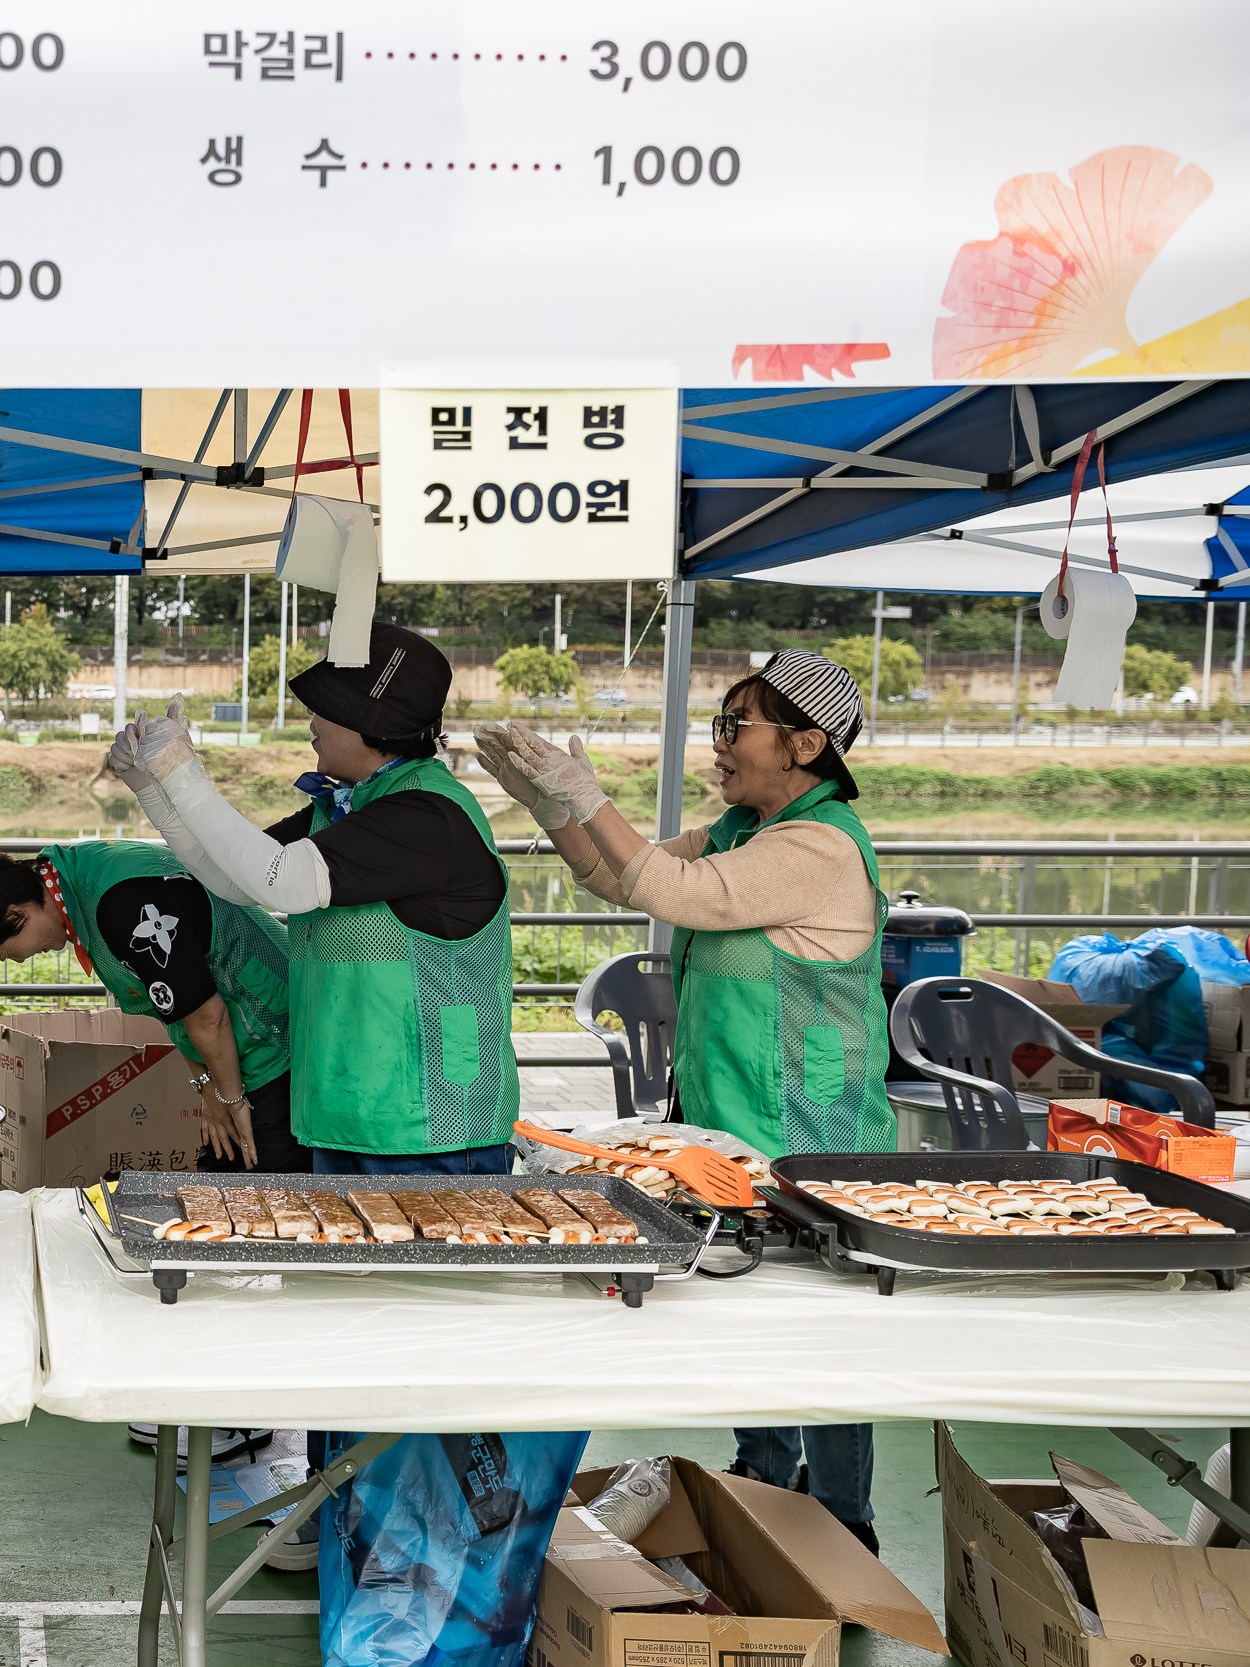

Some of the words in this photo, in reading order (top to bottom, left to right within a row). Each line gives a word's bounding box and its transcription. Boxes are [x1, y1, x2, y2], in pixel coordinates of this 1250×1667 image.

[203, 30, 346, 83] 막걸리
[589, 40, 750, 94] 3,000
[199, 136, 245, 188] 생
[300, 138, 348, 189] 수
[592, 145, 742, 198] 1,000
[430, 406, 474, 452] 밀
[504, 405, 551, 452] 전
[582, 404, 627, 452] 병
[423, 479, 631, 533] 2,000원
